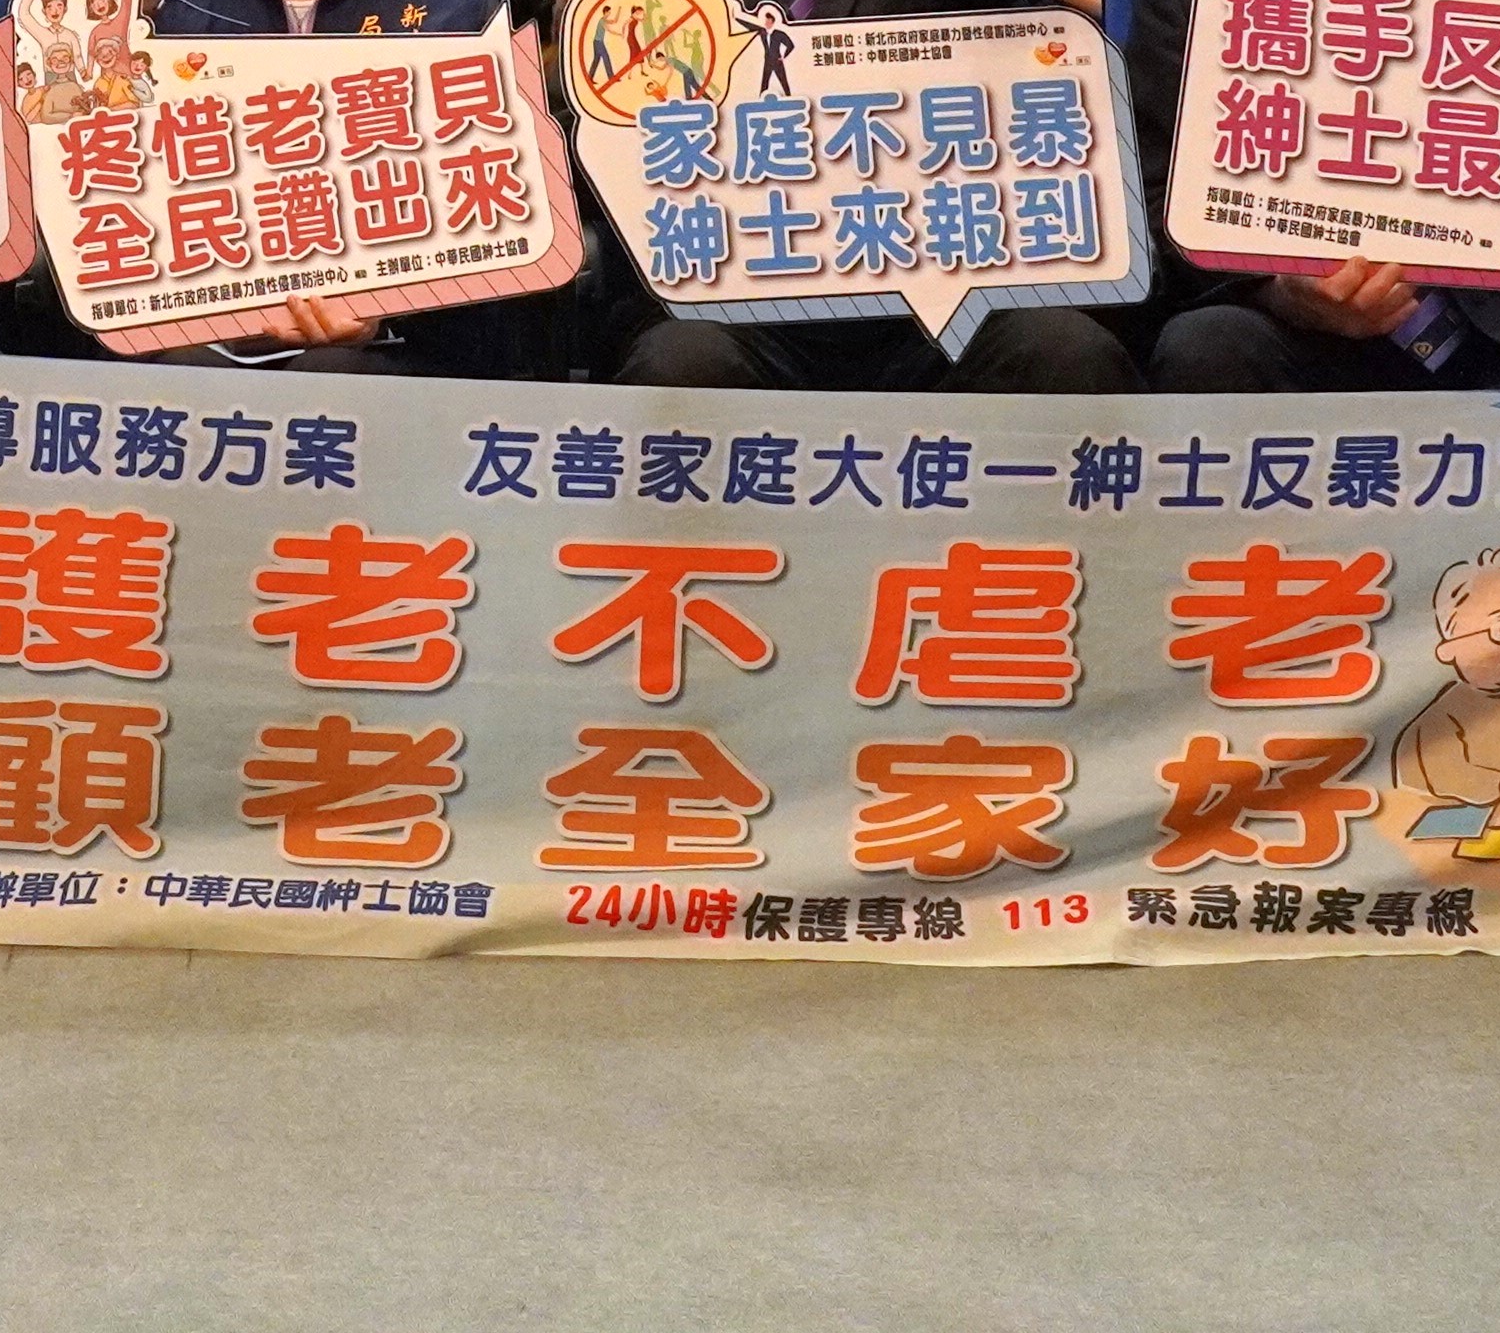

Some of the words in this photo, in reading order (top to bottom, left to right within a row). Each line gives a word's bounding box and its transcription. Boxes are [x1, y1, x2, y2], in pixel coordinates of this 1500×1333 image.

[61, 54, 511, 195] 疼惜老寶貝
[640, 79, 1091, 186] 家庭不見暴
[645, 174, 1100, 282] 紳士來報到
[1003, 892, 1089, 930] 113
[1127, 883, 1479, 935] 緊急報案專線
